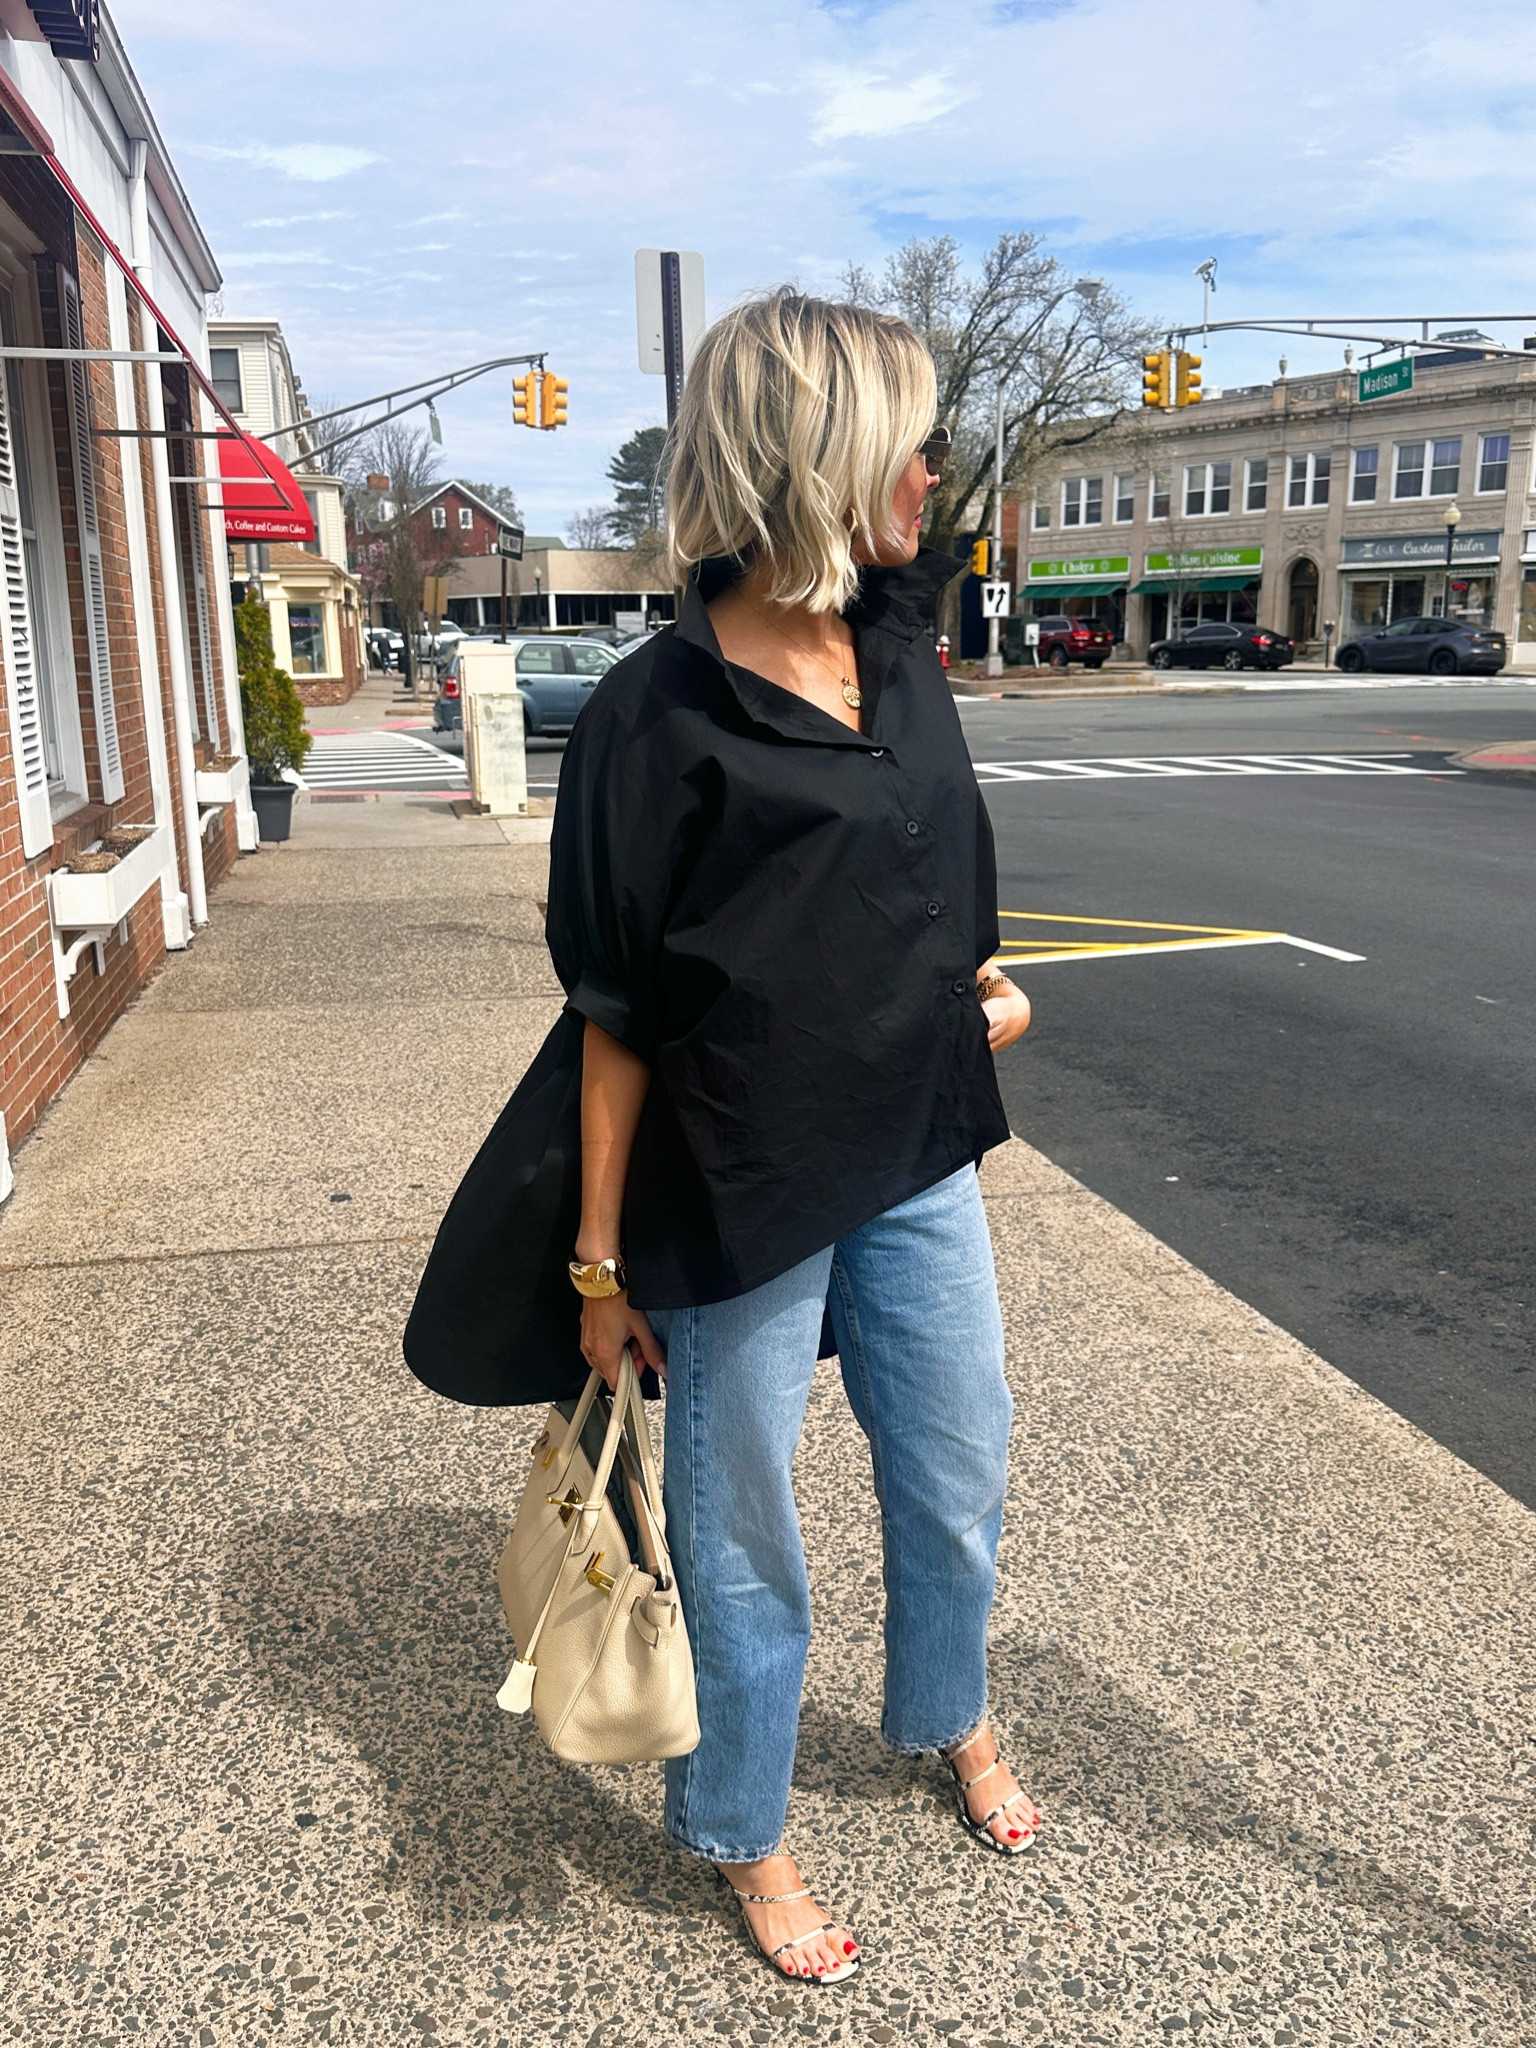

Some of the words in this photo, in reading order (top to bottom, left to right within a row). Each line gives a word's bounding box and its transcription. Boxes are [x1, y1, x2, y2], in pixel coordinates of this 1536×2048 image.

[1363, 372, 1398, 395] Madison
[1402, 366, 1409, 378] St
[235, 520, 254, 531] Coffee
[255, 522, 266, 532] and
[266, 522, 289, 533] Custom
[289, 523, 306, 535] Cakes
[1402, 541, 1444, 555] Custom
[1451, 537, 1485, 553] Tailor
[1062, 560, 1095, 576] Chakra
[1202, 551, 1241, 568] Cuisine
